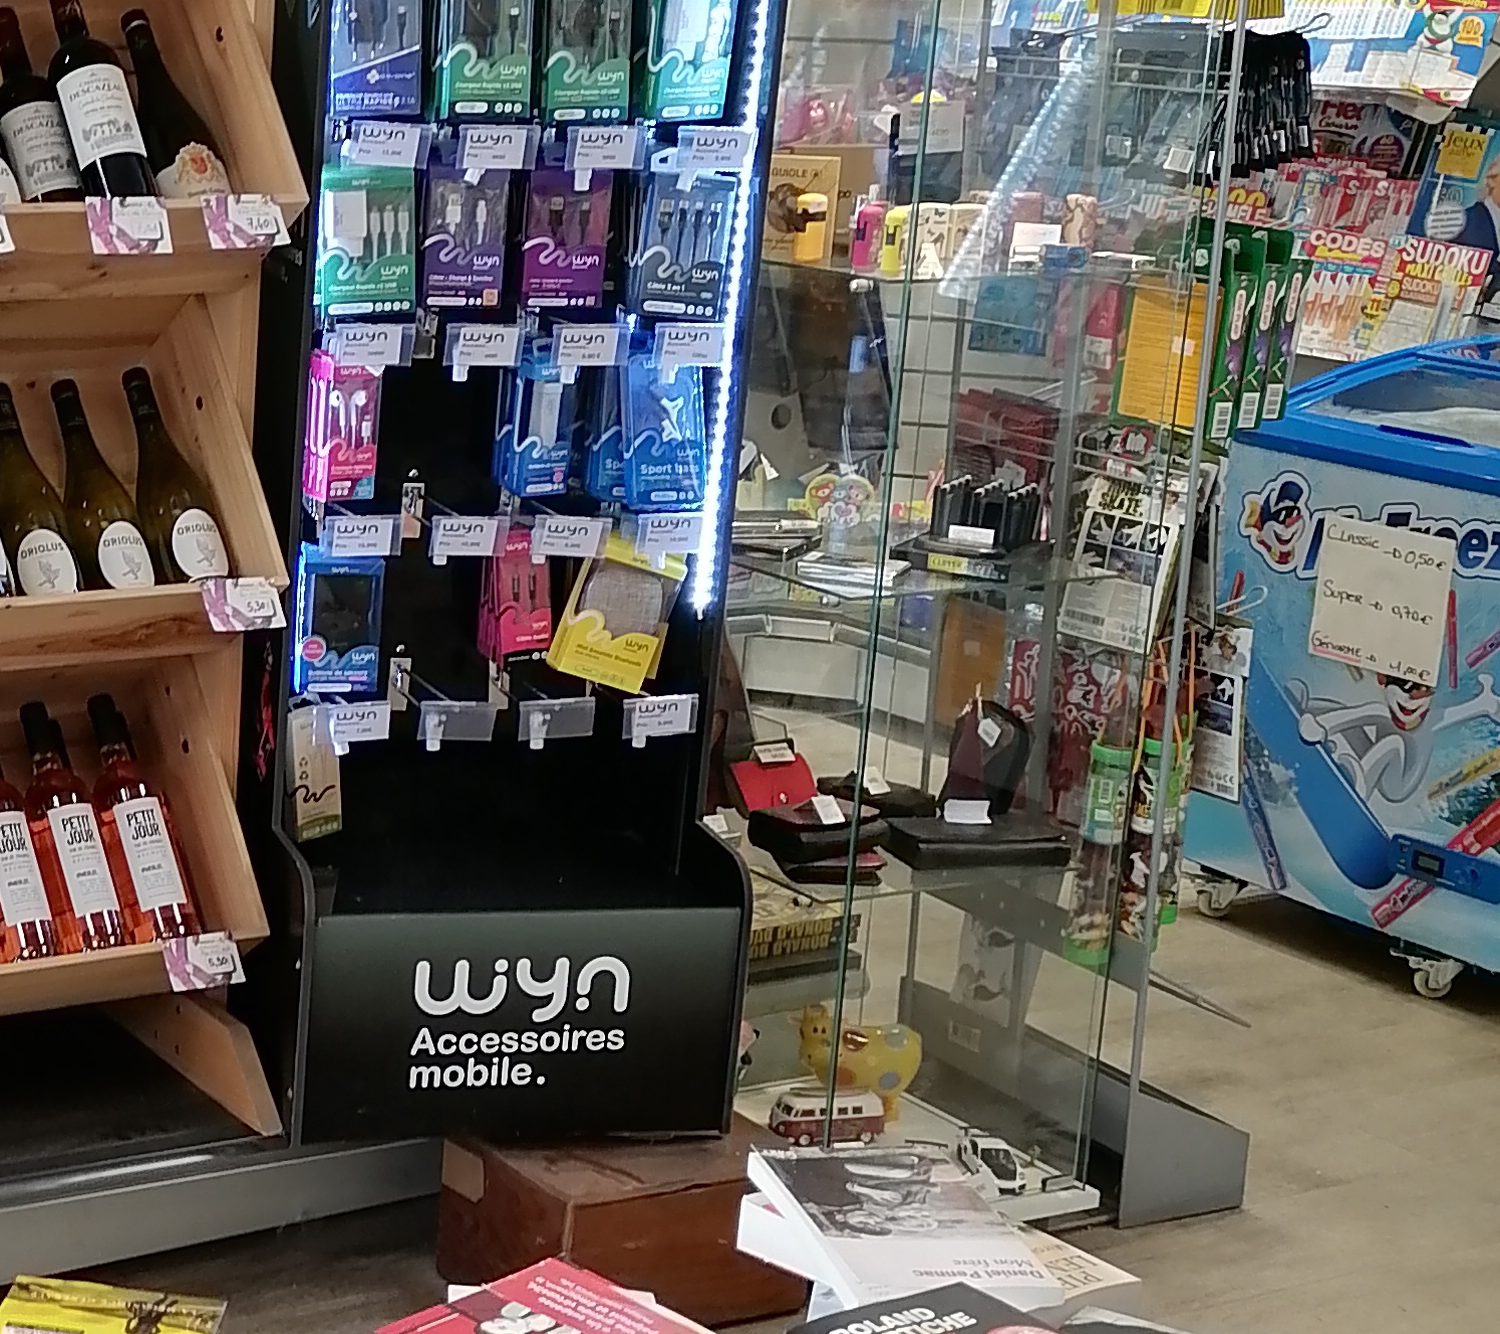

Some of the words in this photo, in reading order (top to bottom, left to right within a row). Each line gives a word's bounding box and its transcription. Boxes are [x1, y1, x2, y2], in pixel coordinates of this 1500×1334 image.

[362, 127, 405, 144] wyn
[470, 131, 513, 147] wyn
[1444, 129, 1486, 152] Jeux
[1402, 239, 1490, 276] SUDOKU
[19, 541, 66, 561] ORIOLUS
[61, 814, 92, 833] PETIT
[125, 807, 156, 827] PETIT
[66, 827, 96, 846] JOUR
[130, 822, 161, 841] JOUR
[413, 954, 631, 1023] wyn
[409, 1024, 626, 1058] Accessoires
[408, 1055, 547, 1090] mobile.
